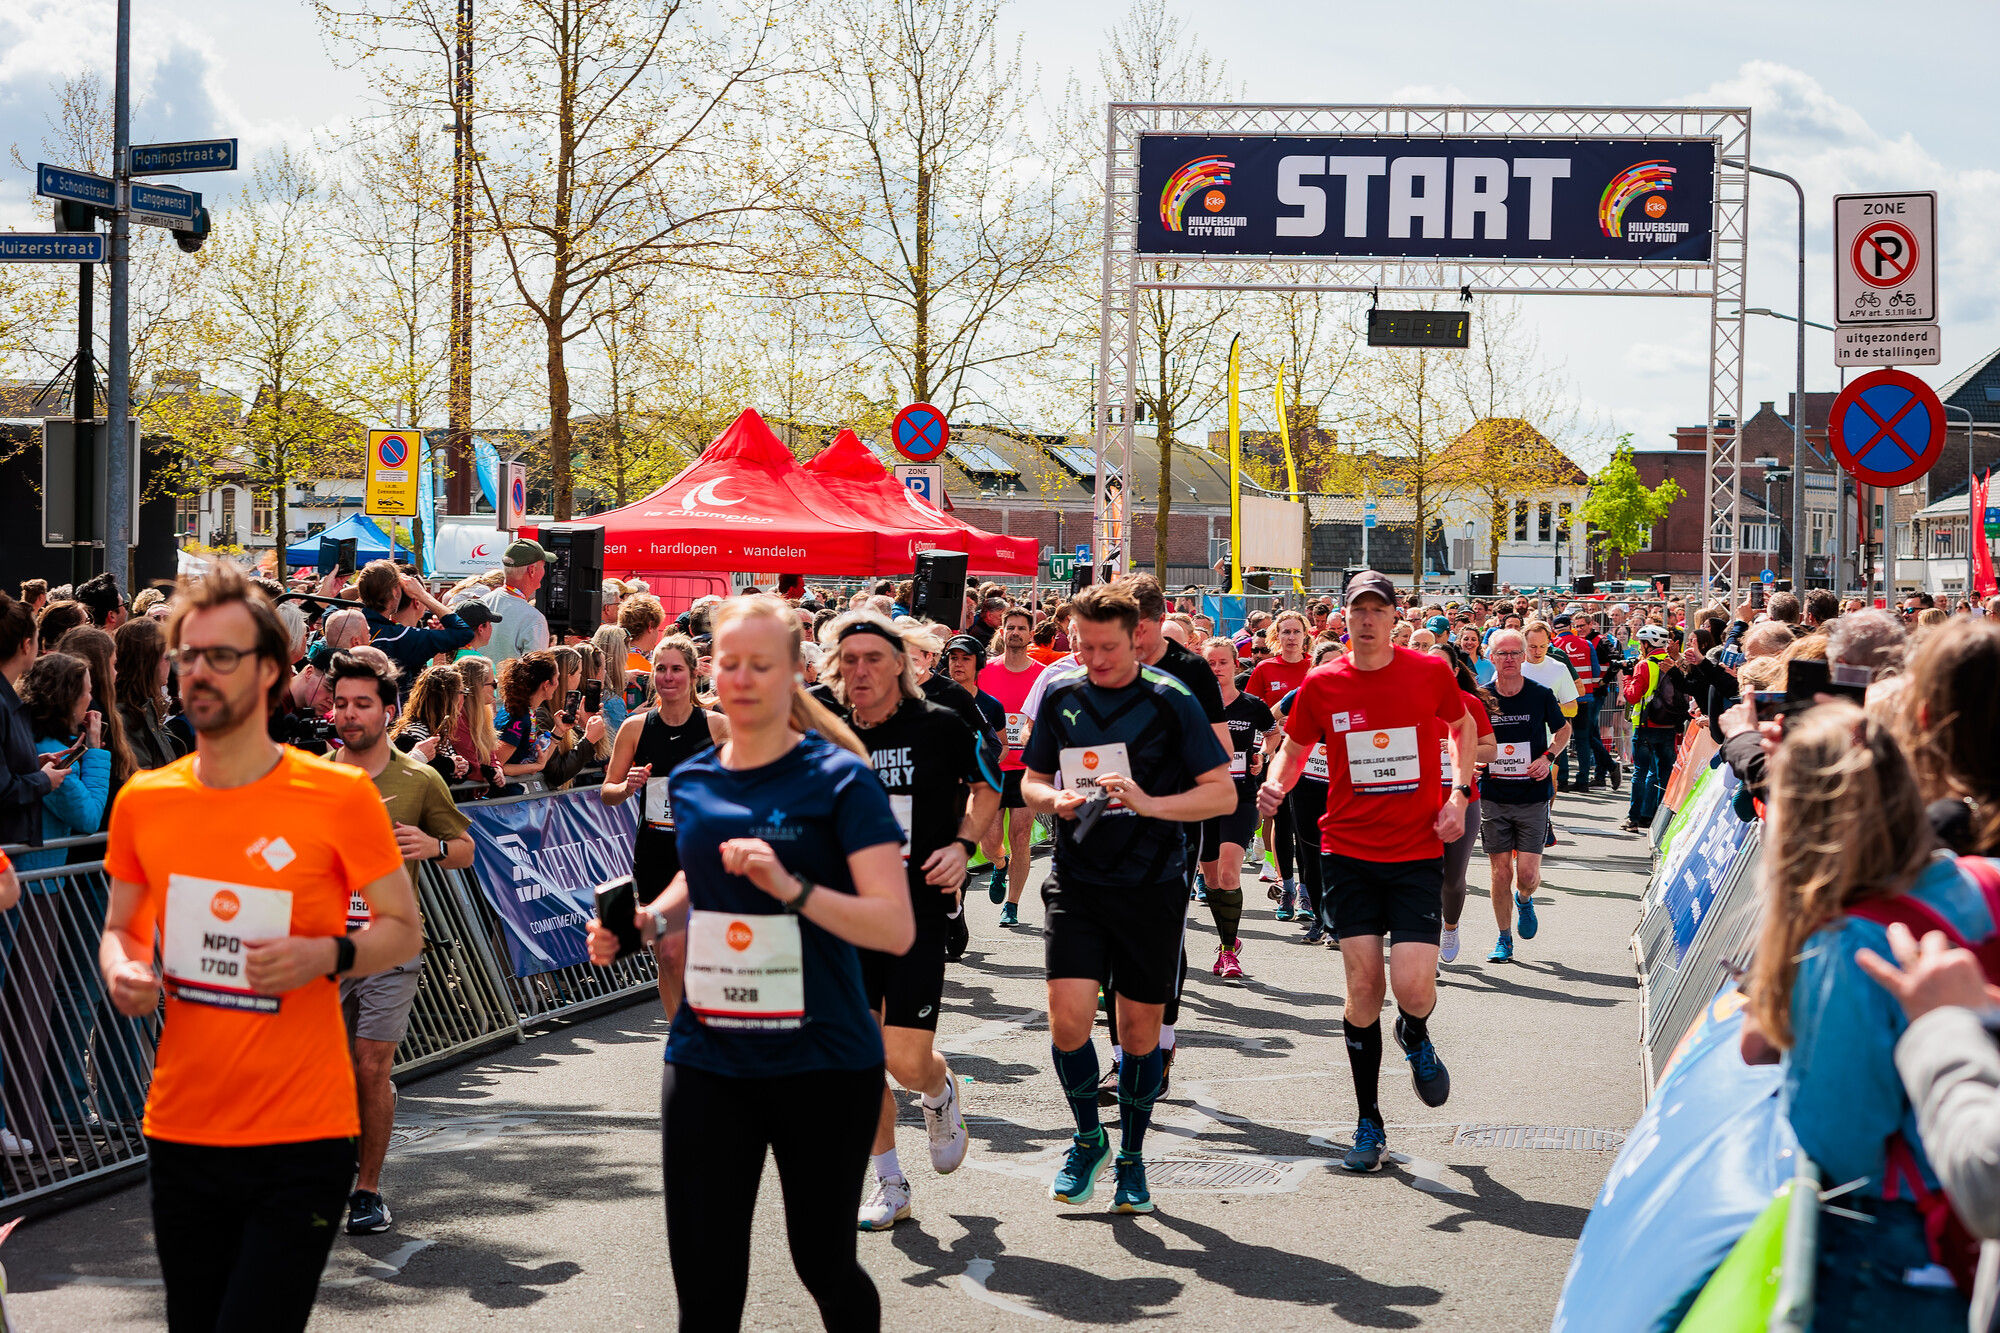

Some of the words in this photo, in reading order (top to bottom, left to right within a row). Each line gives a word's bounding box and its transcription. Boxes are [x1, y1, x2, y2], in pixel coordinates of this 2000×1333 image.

[135, 146, 214, 167] Honingstraat
[58, 176, 110, 199] Schoolstraat
[137, 188, 186, 210] Langgewenst
[1276, 155, 1571, 240] START
[1863, 203, 1906, 215] ZONE
[1188, 216, 1247, 227] HILVERSUM
[1628, 222, 1689, 233] HILVERSUM
[1188, 226, 1213, 236] CITY
[1214, 226, 1236, 237] RUN
[1628, 232, 1653, 242] CITY
[1655, 232, 1677, 243] RUN
[1846, 331, 1928, 345] uitgezonderd
[1838, 348, 1850, 358] in
[1854, 347, 1869, 358] de
[1872, 347, 1936, 359] stallingen
[666, 509, 774, 524] Champion
[650, 542, 717, 557] hardlopen
[743, 545, 807, 558] wandelen
[1373, 768, 1397, 778] 1340
[530, 912, 582, 934] COMMITMENT
[203, 932, 240, 953] NPO
[201, 957, 239, 977] 1700
[723, 987, 759, 1003] 1228
